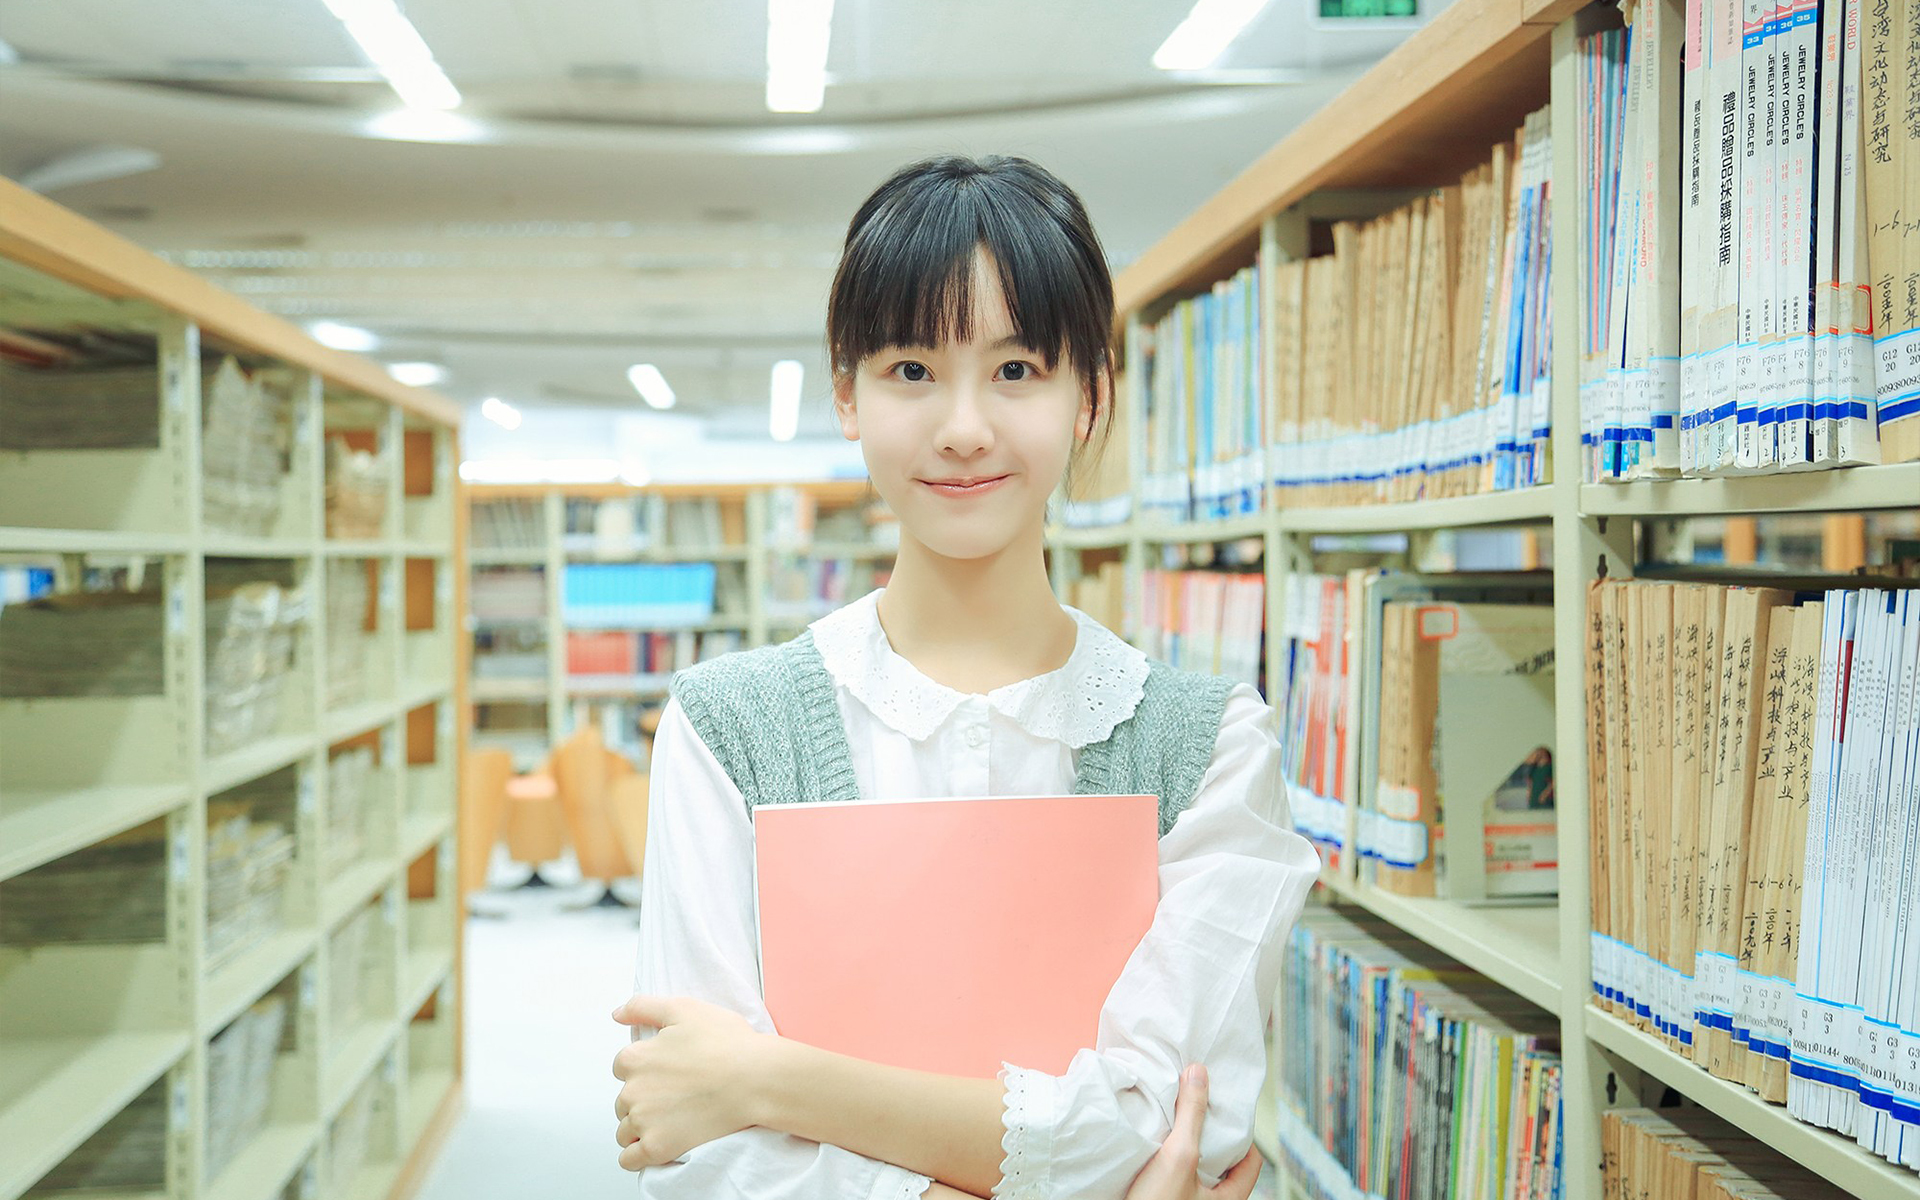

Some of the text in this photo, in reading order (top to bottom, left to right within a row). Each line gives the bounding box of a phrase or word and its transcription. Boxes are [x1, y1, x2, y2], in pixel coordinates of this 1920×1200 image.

[1847, 8, 1857, 50] WORLD
[1747, 36, 1760, 44] 33
[1782, 51, 1790, 96] JEWELRY
[1796, 44, 1806, 140] JEWELRY CIRCLE'S
[1747, 66, 1756, 158] JEWELRY CIRCLE'S
[1766, 102, 1774, 146] CIRCLE'S
[1882, 349, 1898, 362] G12
[1741, 367, 1746, 376] 8
[1886, 362, 1896, 372] 20
[1824, 1012, 1834, 1023] G3
[1824, 1024, 1830, 1034] 3
[1887, 1036, 1898, 1048] G3
[1871, 1044, 1876, 1054] 3
[1908, 1047, 1920, 1058] G3
[1890, 1050, 1895, 1060] 3
[1910, 1060, 1916, 1070] 3
